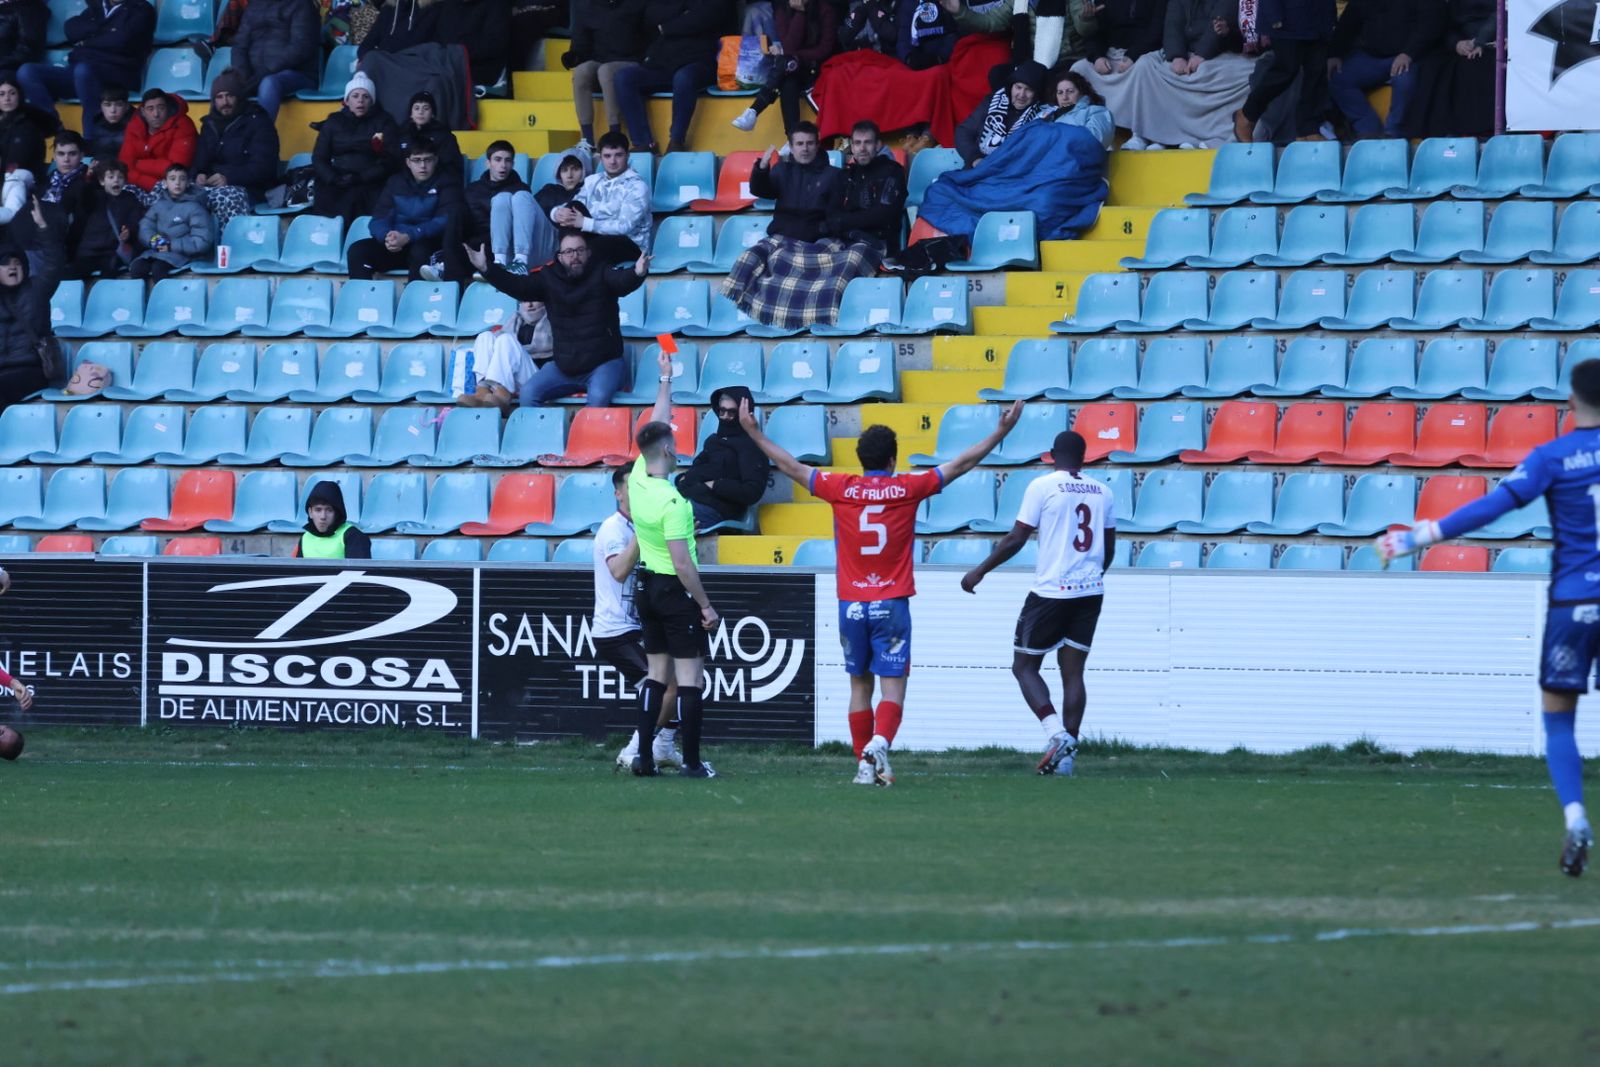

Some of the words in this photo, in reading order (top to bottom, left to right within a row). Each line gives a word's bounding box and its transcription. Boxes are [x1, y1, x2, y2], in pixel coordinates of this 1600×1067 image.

[528, 114, 536, 127] 9
[1122, 221, 1131, 234] 8
[1054, 281, 1063, 298] 7
[899, 344, 915, 355] 55
[985, 348, 994, 362] 6
[844, 485, 860, 499] DE
[862, 485, 906, 500] FRUTOS
[859, 504, 887, 555] 5
[1072, 502, 1093, 552] 3
[162, 652, 460, 689] DISCOSA
[160, 698, 195, 719] DE
[201, 699, 407, 728] ALIMENTACION,
[416, 705, 462, 727] S.L.
